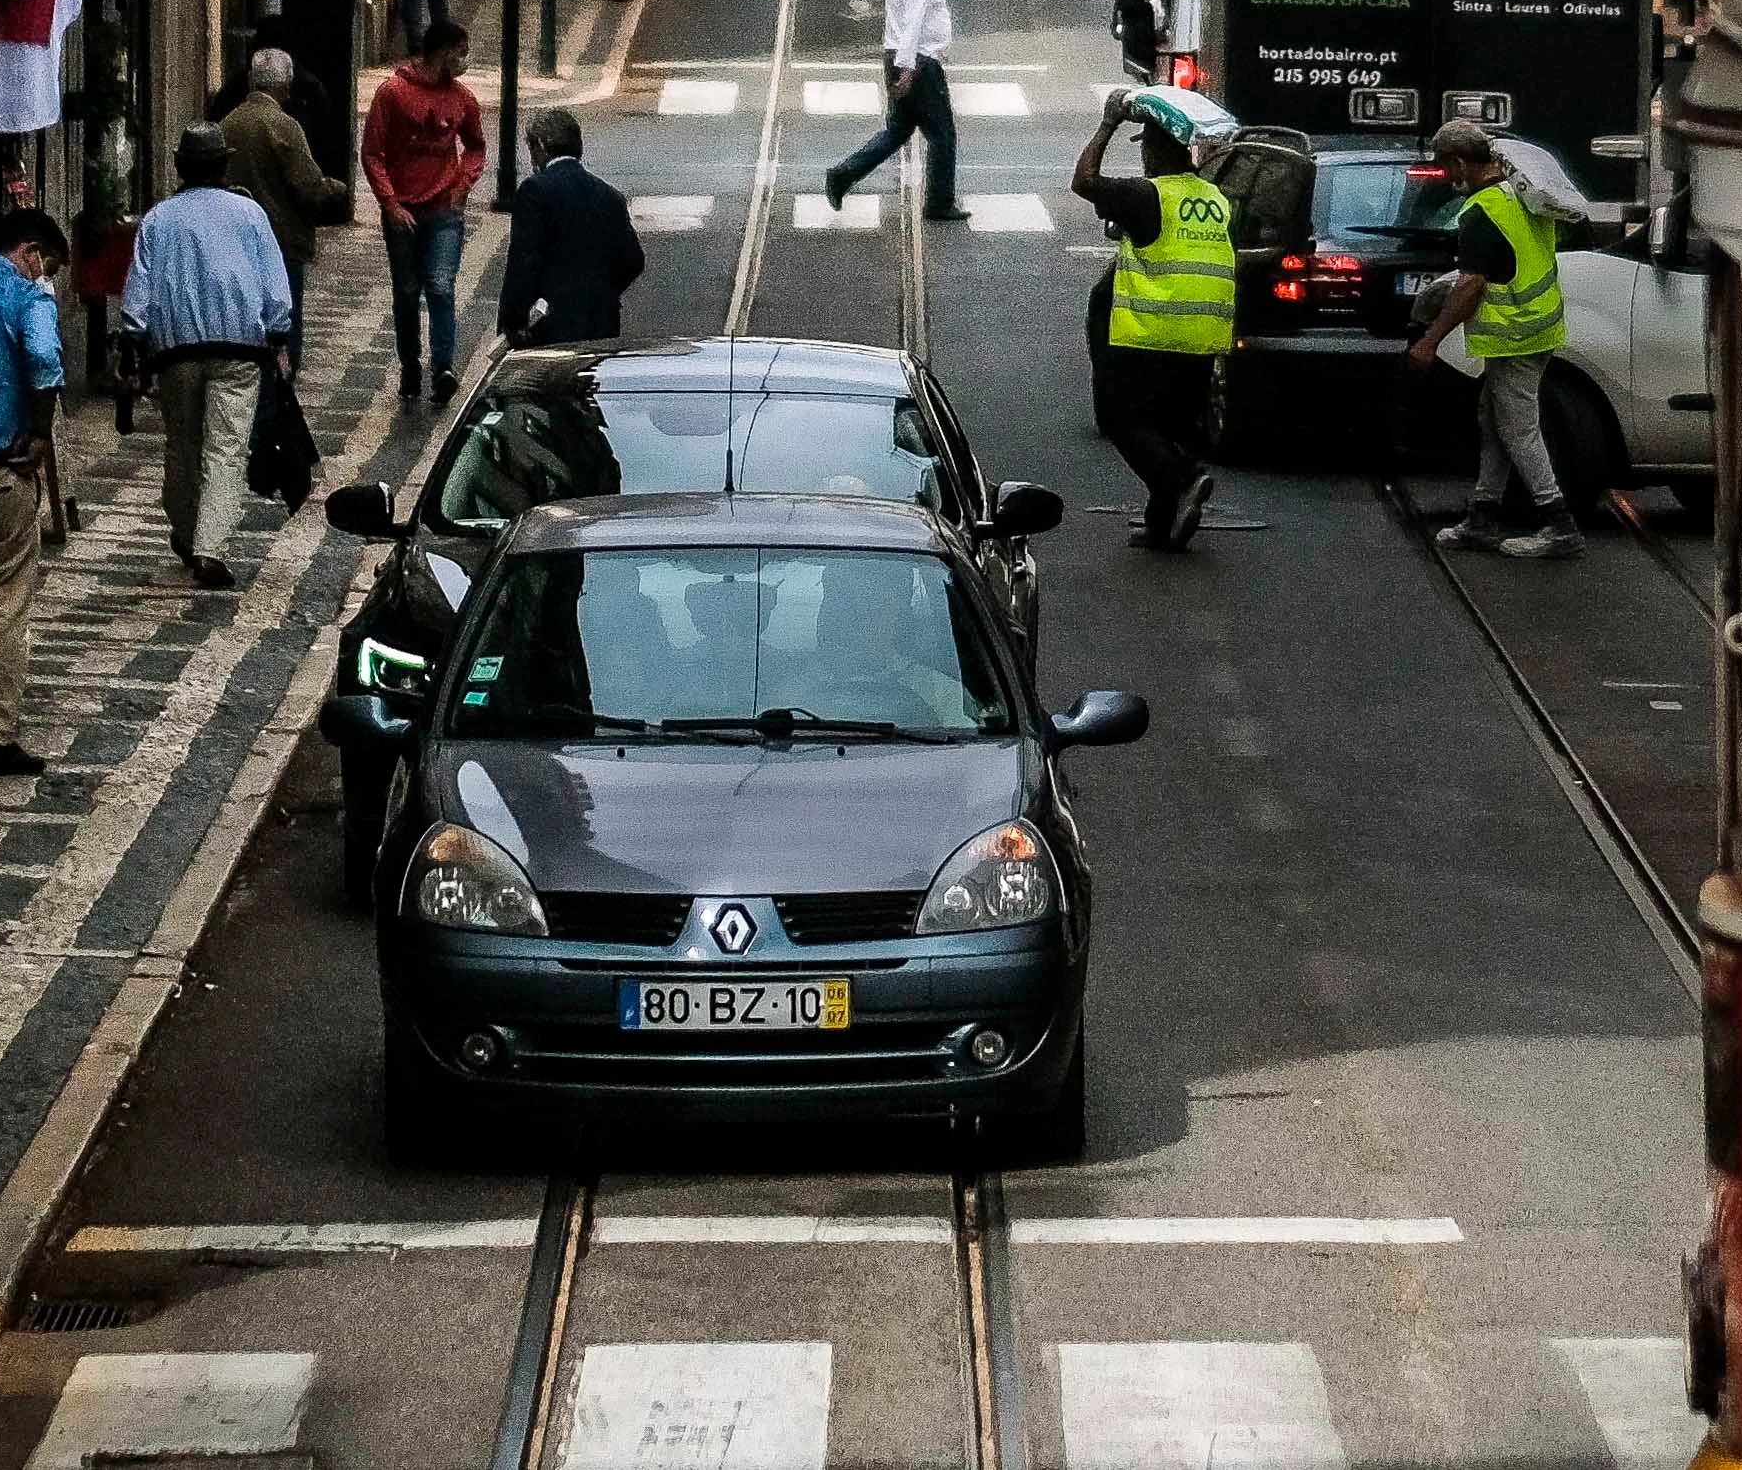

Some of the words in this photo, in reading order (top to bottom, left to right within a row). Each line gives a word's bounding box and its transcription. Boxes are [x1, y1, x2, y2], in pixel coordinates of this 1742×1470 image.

[1453, 0, 1493, 13] Sintra
[1505, 2, 1551, 14] Loures
[1563, 2, 1621, 16] Odivelas
[1259, 45, 1398, 66] hortadobairro.pt
[1274, 68, 1303, 83] 215
[1309, 69, 1342, 86] 995
[1347, 68, 1382, 87] 649
